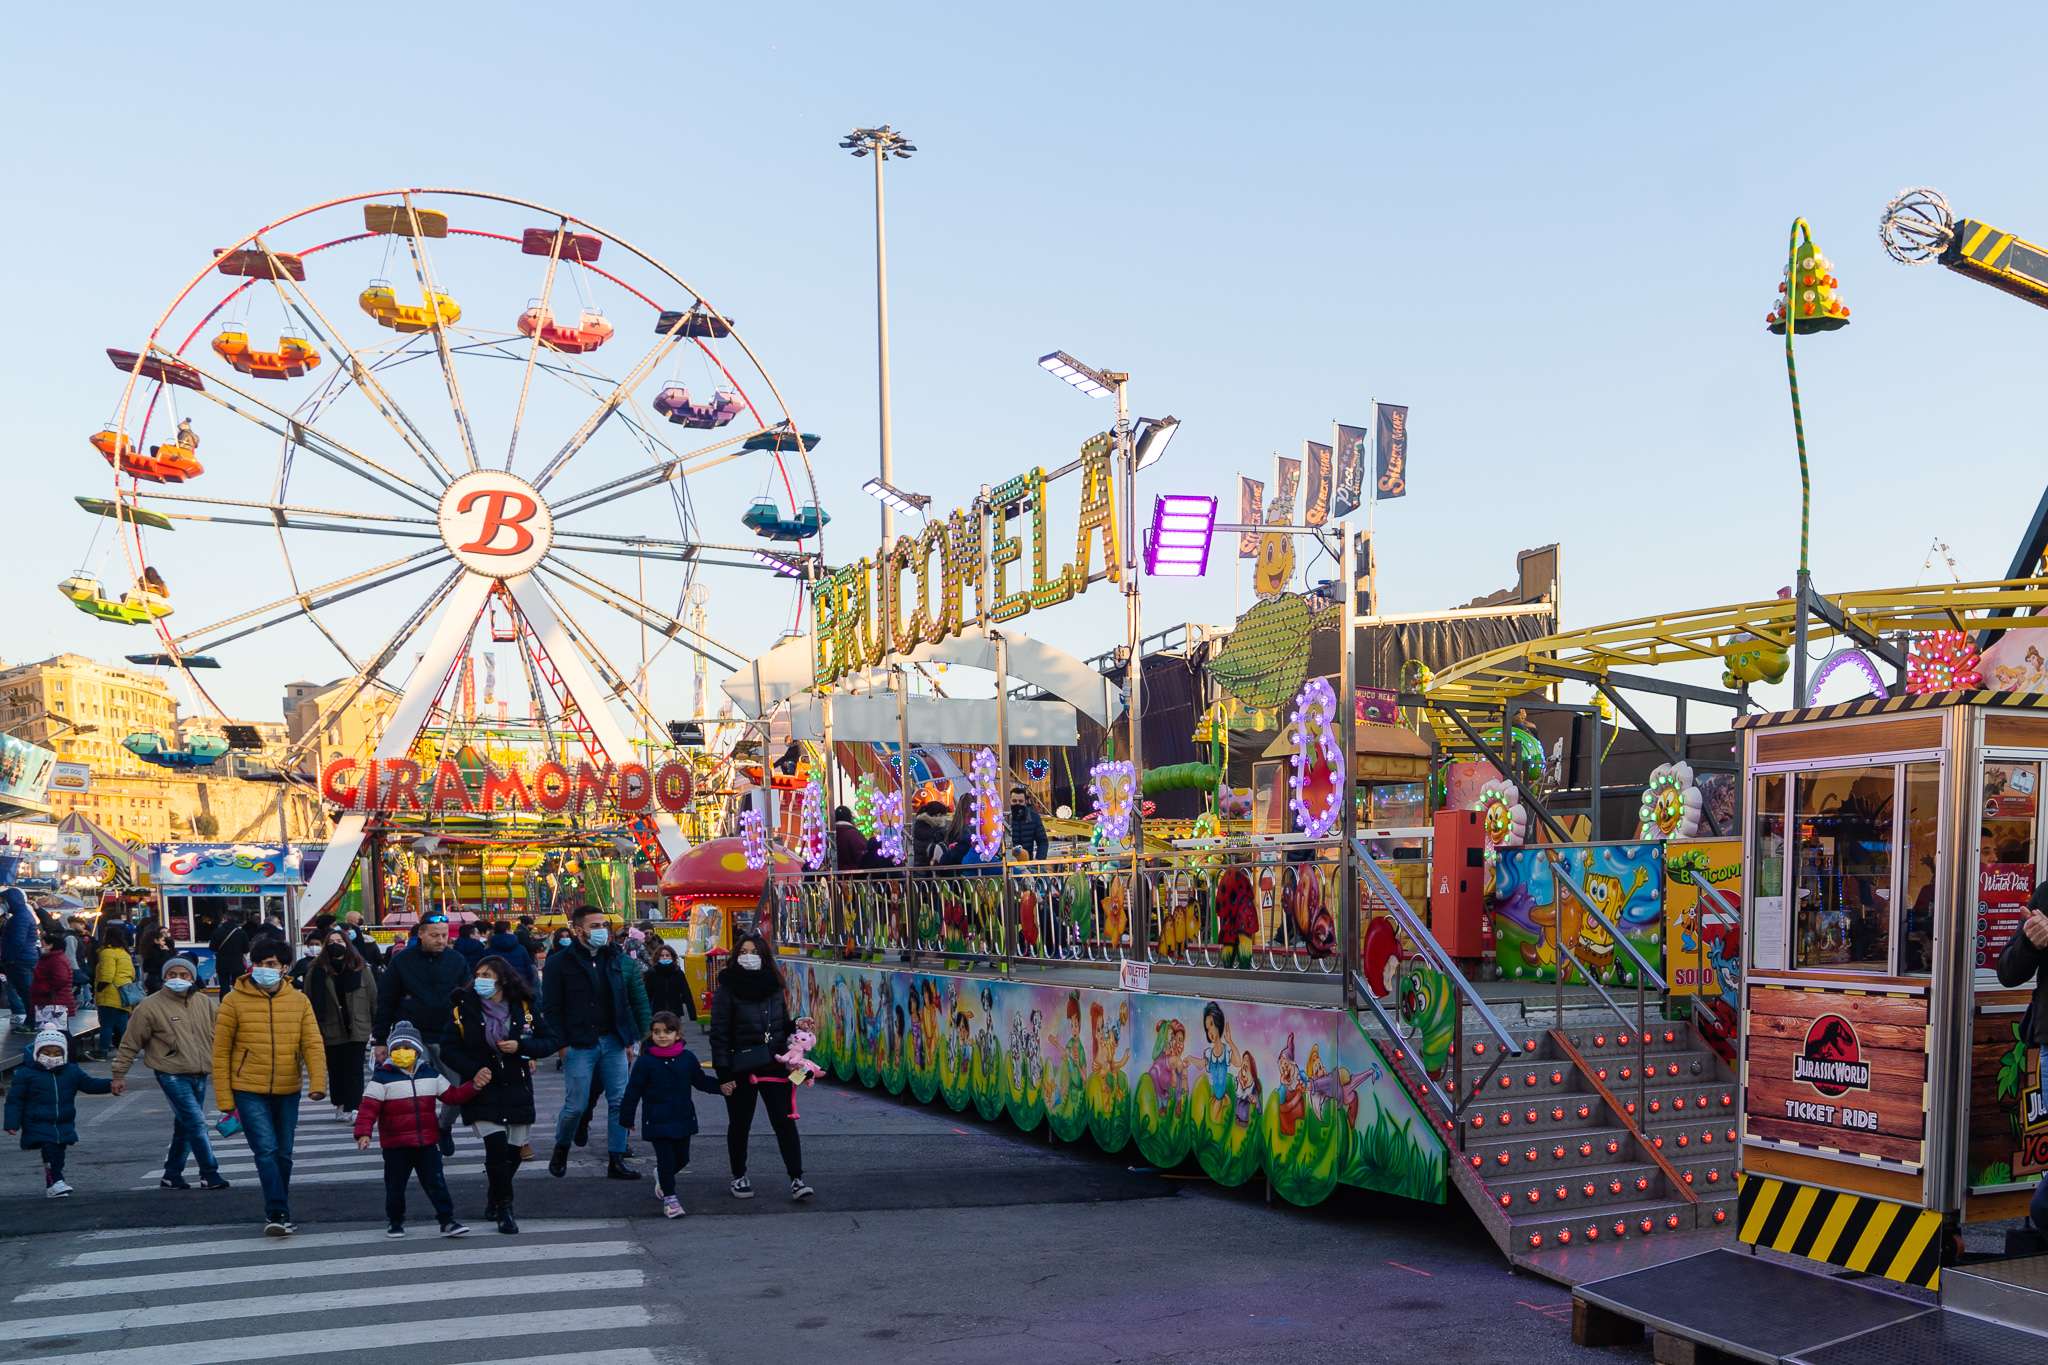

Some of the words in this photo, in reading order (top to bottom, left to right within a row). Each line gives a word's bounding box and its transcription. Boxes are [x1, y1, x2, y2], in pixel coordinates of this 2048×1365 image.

[457, 490, 538, 557] B
[814, 431, 1120, 686] BRUCOMELA
[321, 757, 695, 814] GIRAMONDO
[169, 851, 276, 878] CASSA
[1785, 1100, 1836, 1123] TICKET
[1842, 1108, 1878, 1131] RIDE
